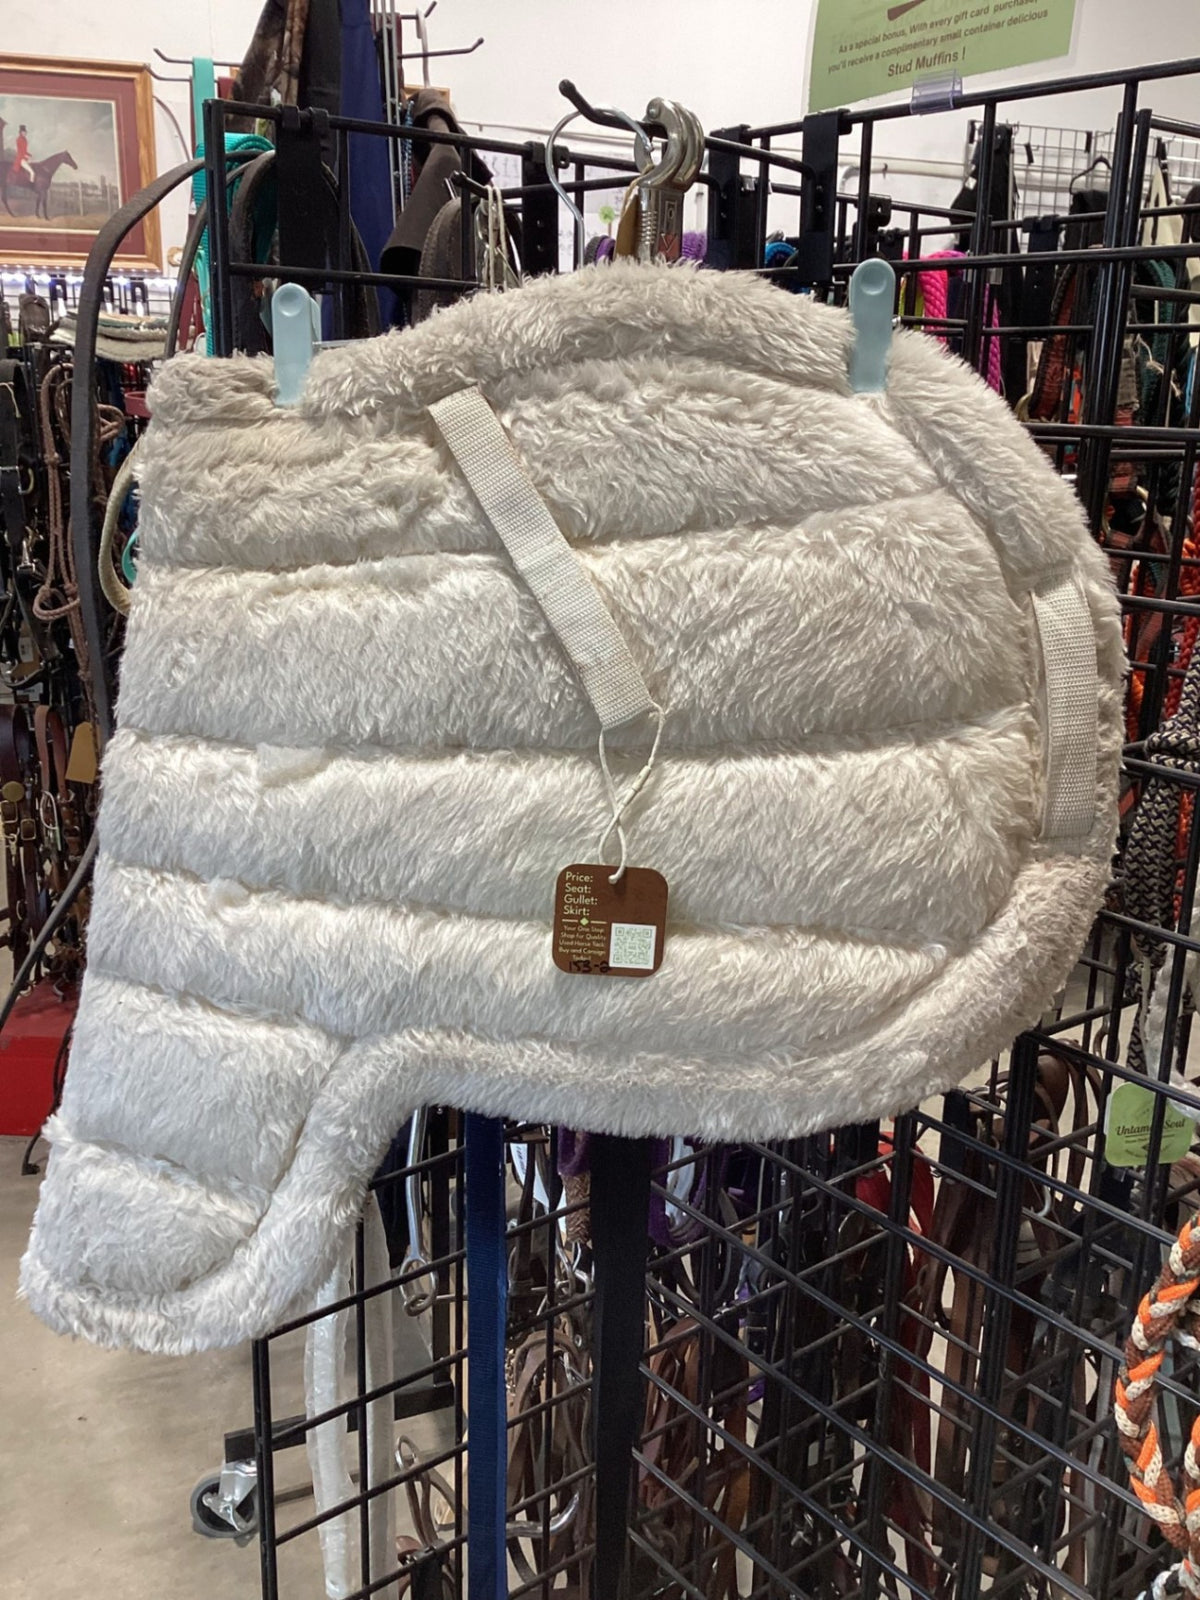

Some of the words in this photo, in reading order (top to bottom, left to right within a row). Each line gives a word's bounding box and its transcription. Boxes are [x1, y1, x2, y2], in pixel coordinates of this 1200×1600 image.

[839, 44, 848, 53] As
[855, 34, 881, 52] special
[883, 29, 907, 43] bonus,
[910, 22, 928, 34] With
[930, 16, 951, 31] every
[954, 11, 968, 26] gift
[970, 6, 989, 19] card
[848, 53, 873, 68] receive
[881, 37, 937, 59] complimentary
[940, 30, 962, 43] small
[964, 21, 1005, 37] container
[1007, 8, 1048, 26] delicious
[887, 61, 912, 77] Stud
[916, 51, 958, 71] Muffins
[566, 872, 593, 882] Price:
[565, 883, 591, 893] Seat:
[564, 894, 598, 905] Gullet:
[564, 905, 590, 915] Skirt:
[1164, 1119, 1186, 1130] Soul
